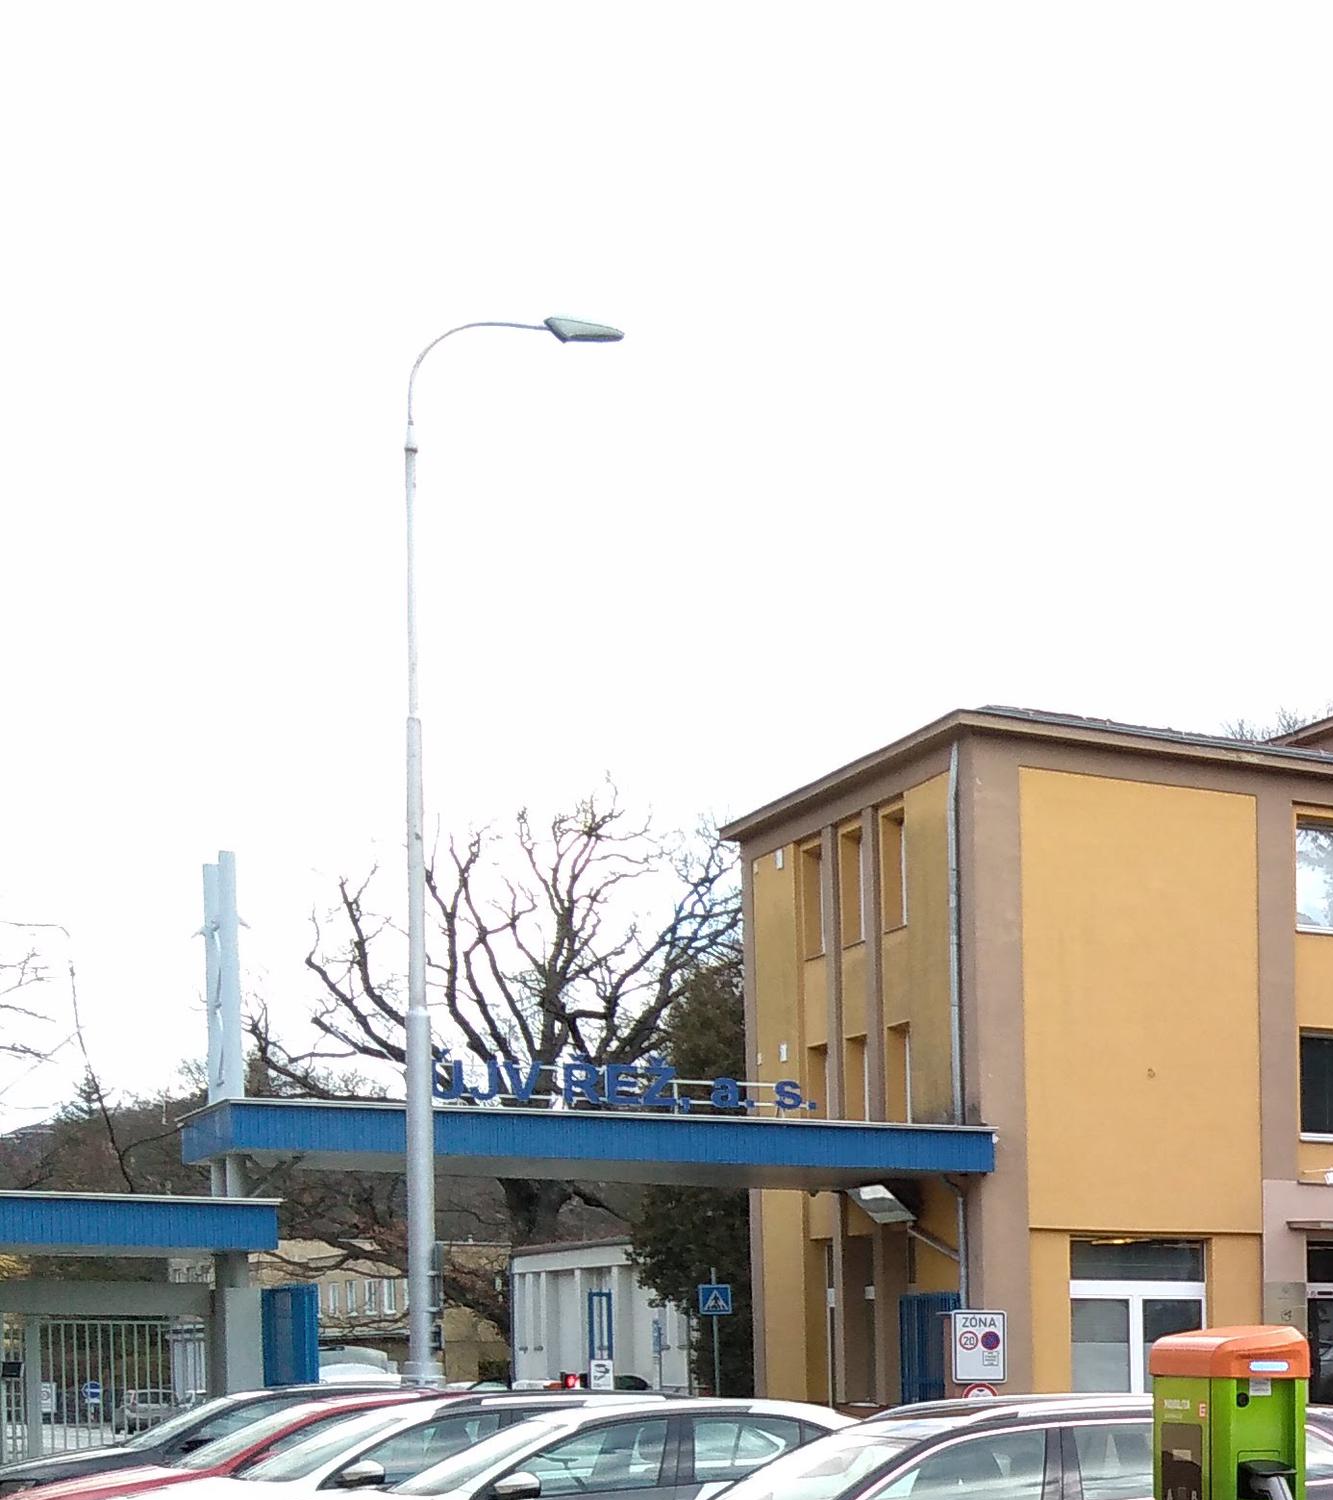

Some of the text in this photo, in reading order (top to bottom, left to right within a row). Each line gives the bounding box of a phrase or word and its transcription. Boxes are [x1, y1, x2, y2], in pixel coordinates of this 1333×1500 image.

[432, 1047, 544, 1102] ÚJV
[711, 1076, 756, 1109] a.
[774, 1078, 818, 1111] s.
[961, 1314, 998, 1328] ZÓNA
[963, 1336, 975, 1346] 20
